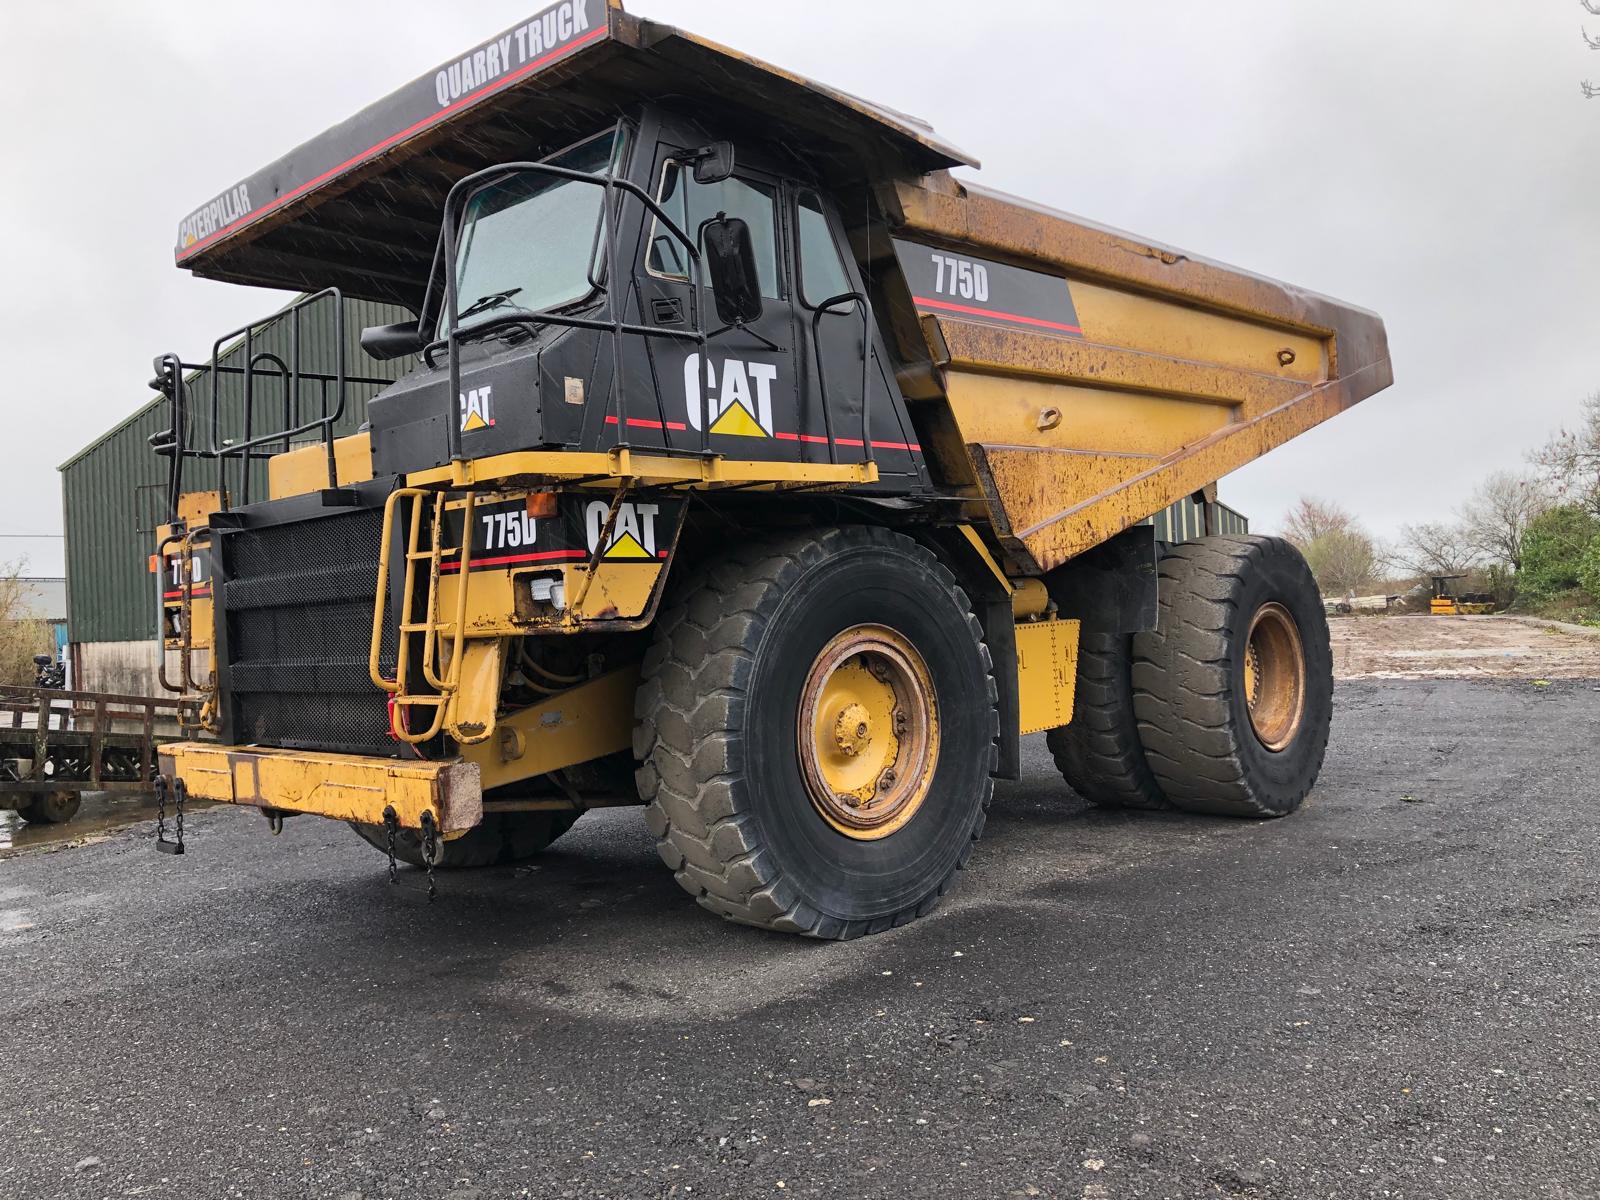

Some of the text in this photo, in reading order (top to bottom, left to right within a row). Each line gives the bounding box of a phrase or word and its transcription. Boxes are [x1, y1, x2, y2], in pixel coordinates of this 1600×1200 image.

[435, 0, 589, 107] QUARRY TRUCK
[181, 183, 252, 249] CATERPILLAR
[932, 254, 989, 302] 775D
[683, 352, 777, 438] CAT
[482, 510, 537, 550] 775D
[585, 501, 659, 558] CAT
